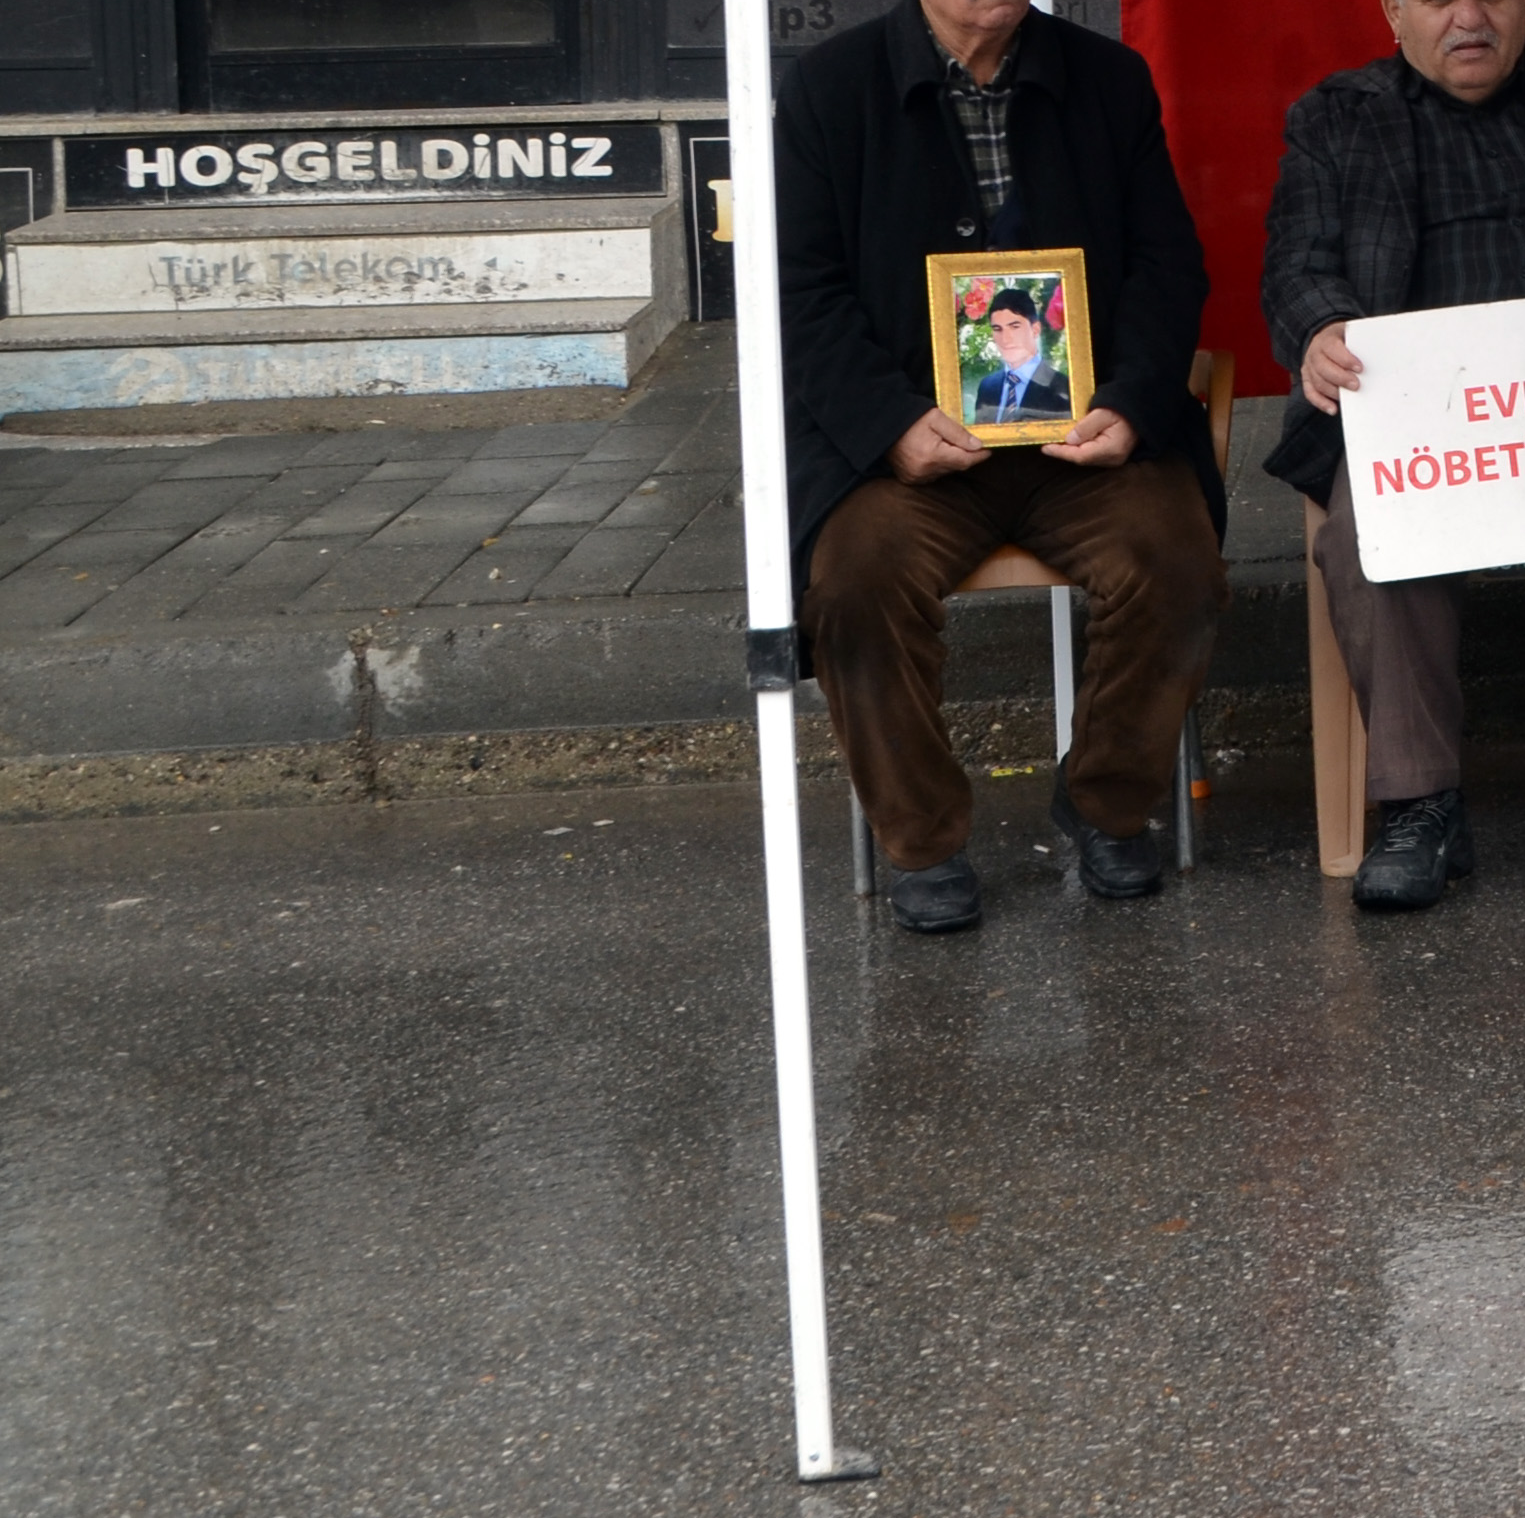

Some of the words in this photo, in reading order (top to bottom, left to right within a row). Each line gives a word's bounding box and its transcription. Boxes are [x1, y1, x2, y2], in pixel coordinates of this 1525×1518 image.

[125, 133, 614, 194] HOŞGELDİNİZ
[158, 255, 252, 288] Türk
[271, 252, 455, 284] Telekom
